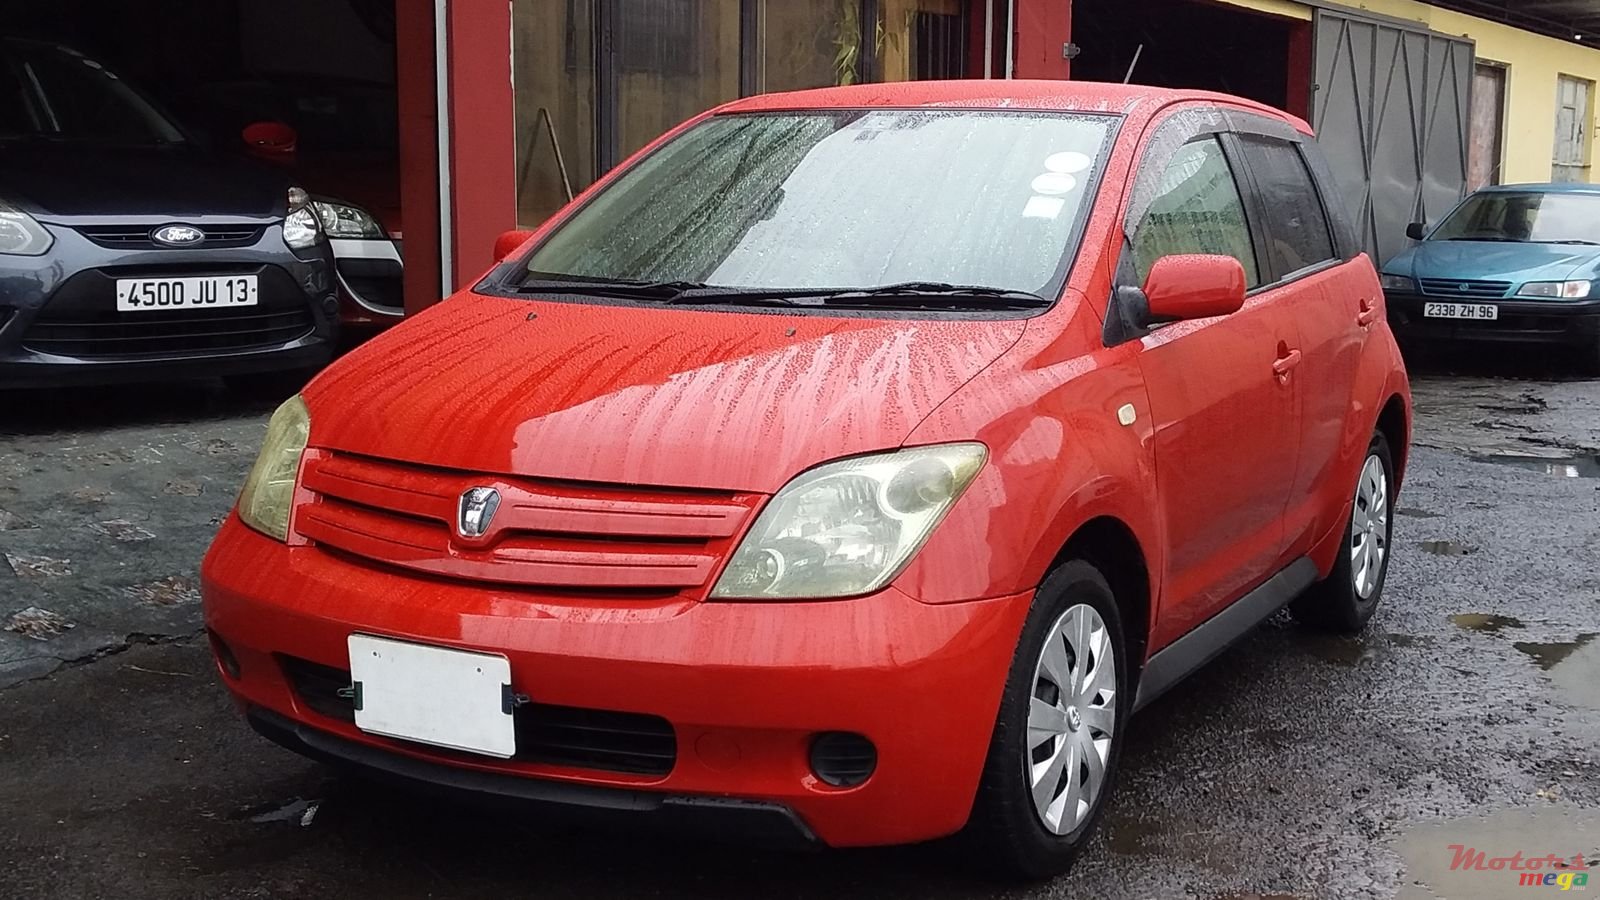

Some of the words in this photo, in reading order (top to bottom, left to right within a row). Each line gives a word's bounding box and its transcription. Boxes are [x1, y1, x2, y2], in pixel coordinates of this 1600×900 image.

[167, 227, 194, 241] Ford
[127, 281, 185, 307] 4500
[192, 280, 217, 304] JU
[225, 279, 248, 303] 13
[1428, 304, 1456, 316] 2338
[1460, 305, 1475, 317] ZH
[1478, 306, 1494, 318] 96
